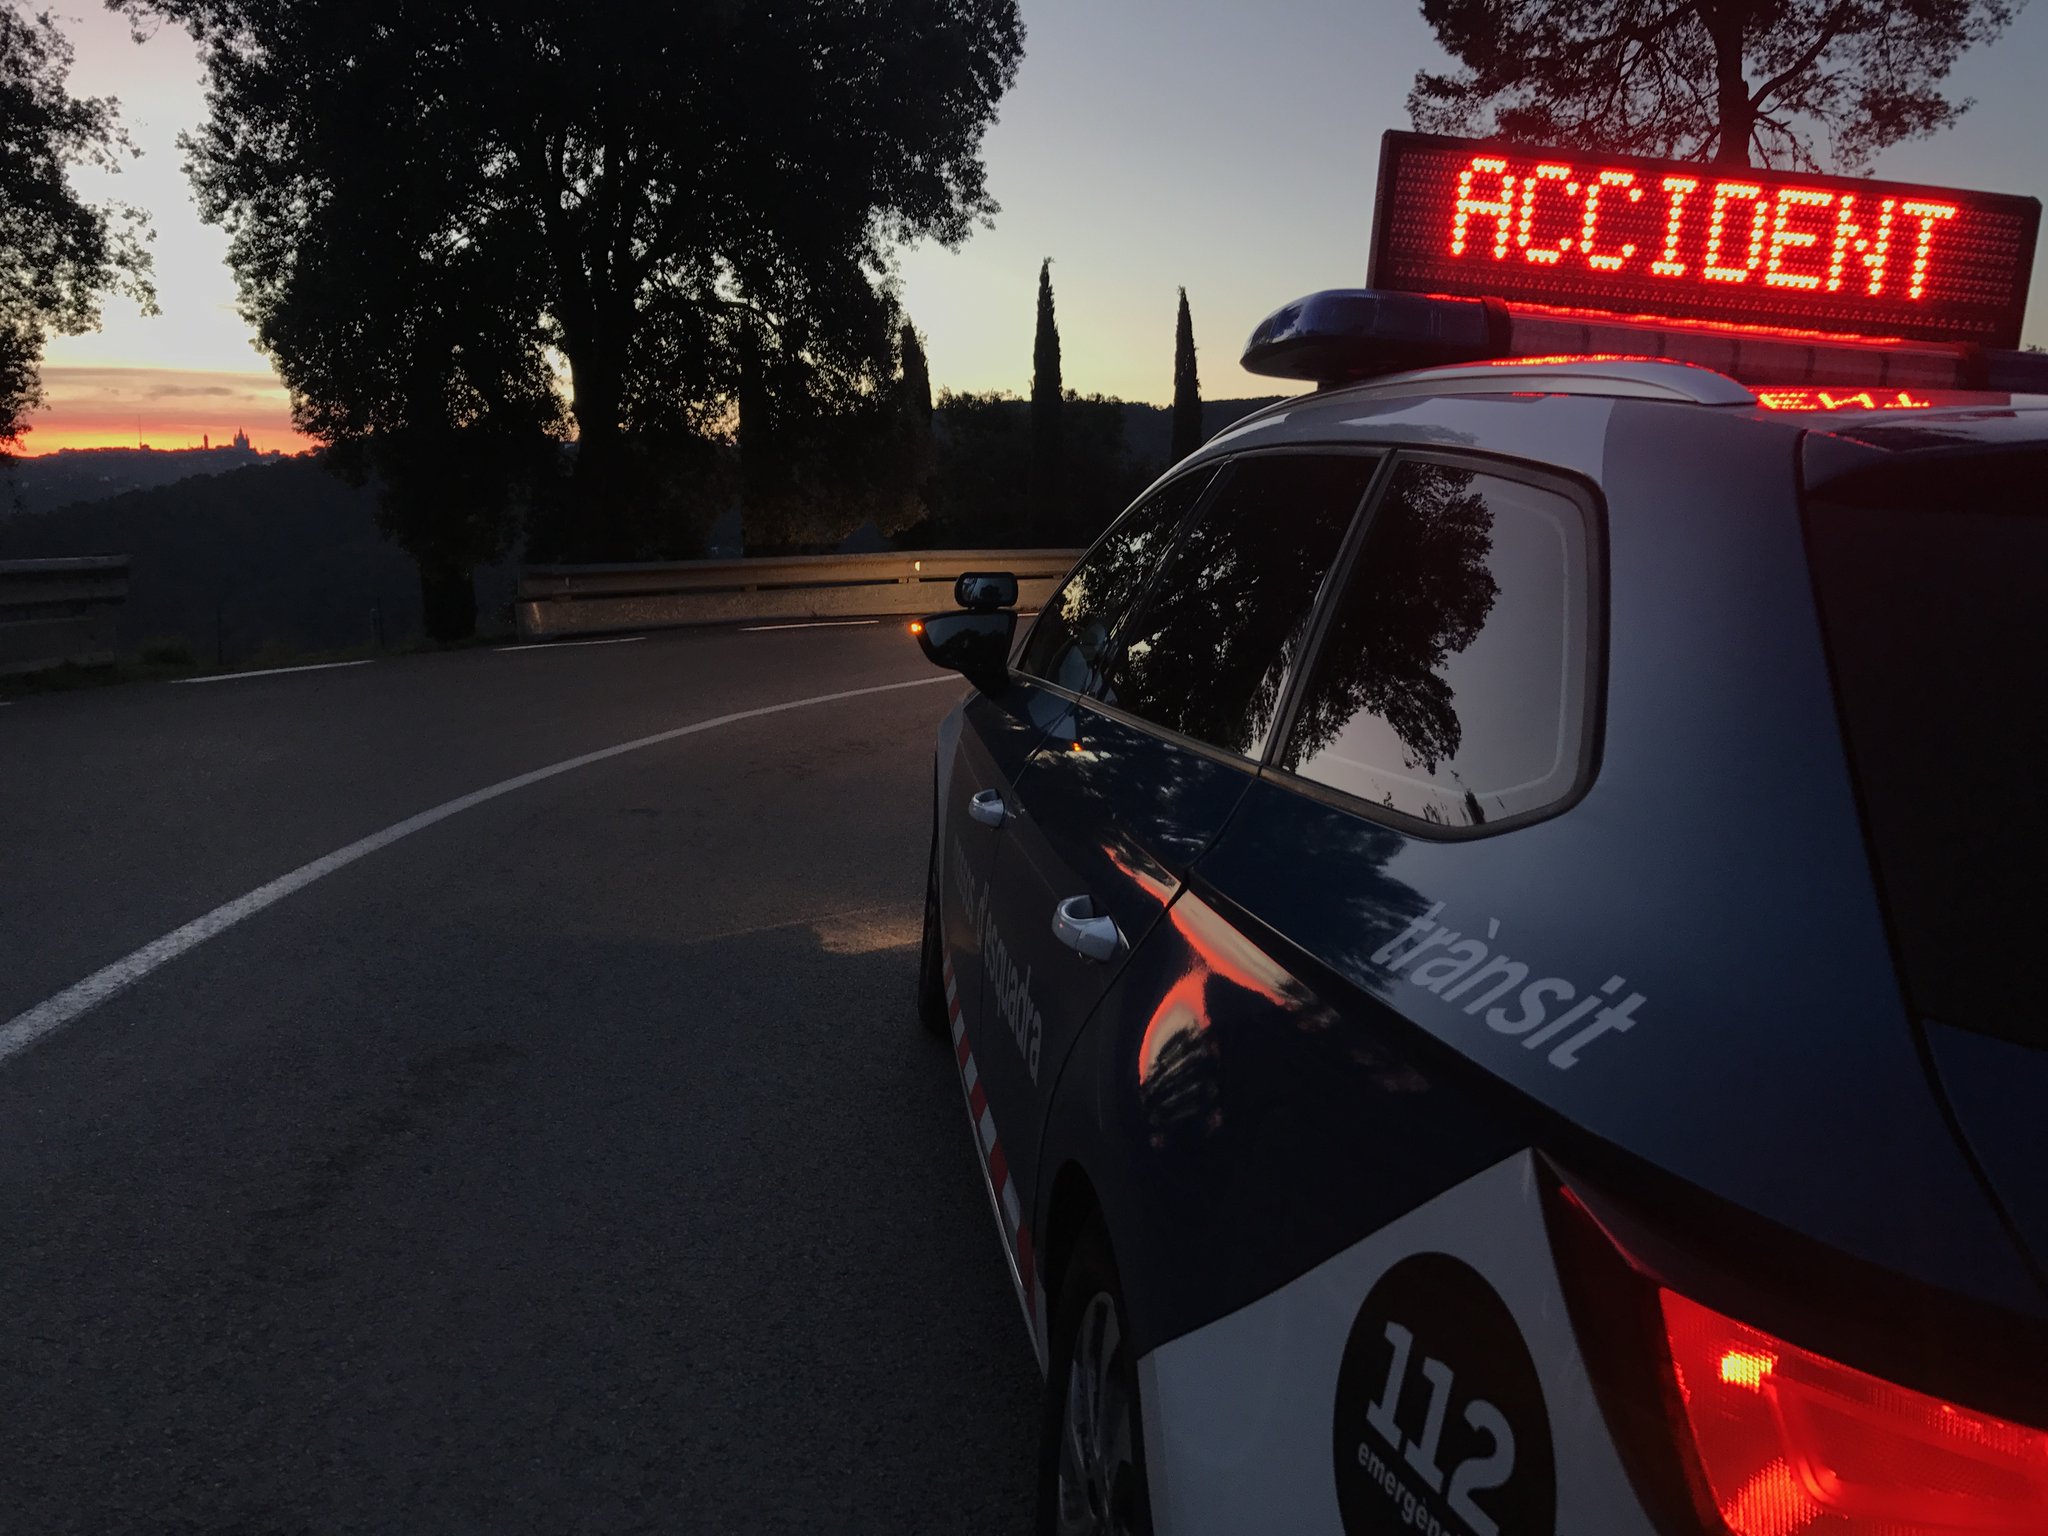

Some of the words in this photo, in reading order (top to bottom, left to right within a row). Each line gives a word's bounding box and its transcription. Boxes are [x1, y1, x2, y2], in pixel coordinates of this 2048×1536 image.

[1450, 156, 1959, 301] ACCIDENT
[1370, 900, 1648, 1070] trànsit
[1357, 1441, 1454, 1536] emergèn
[1365, 1319, 1517, 1536] 112
